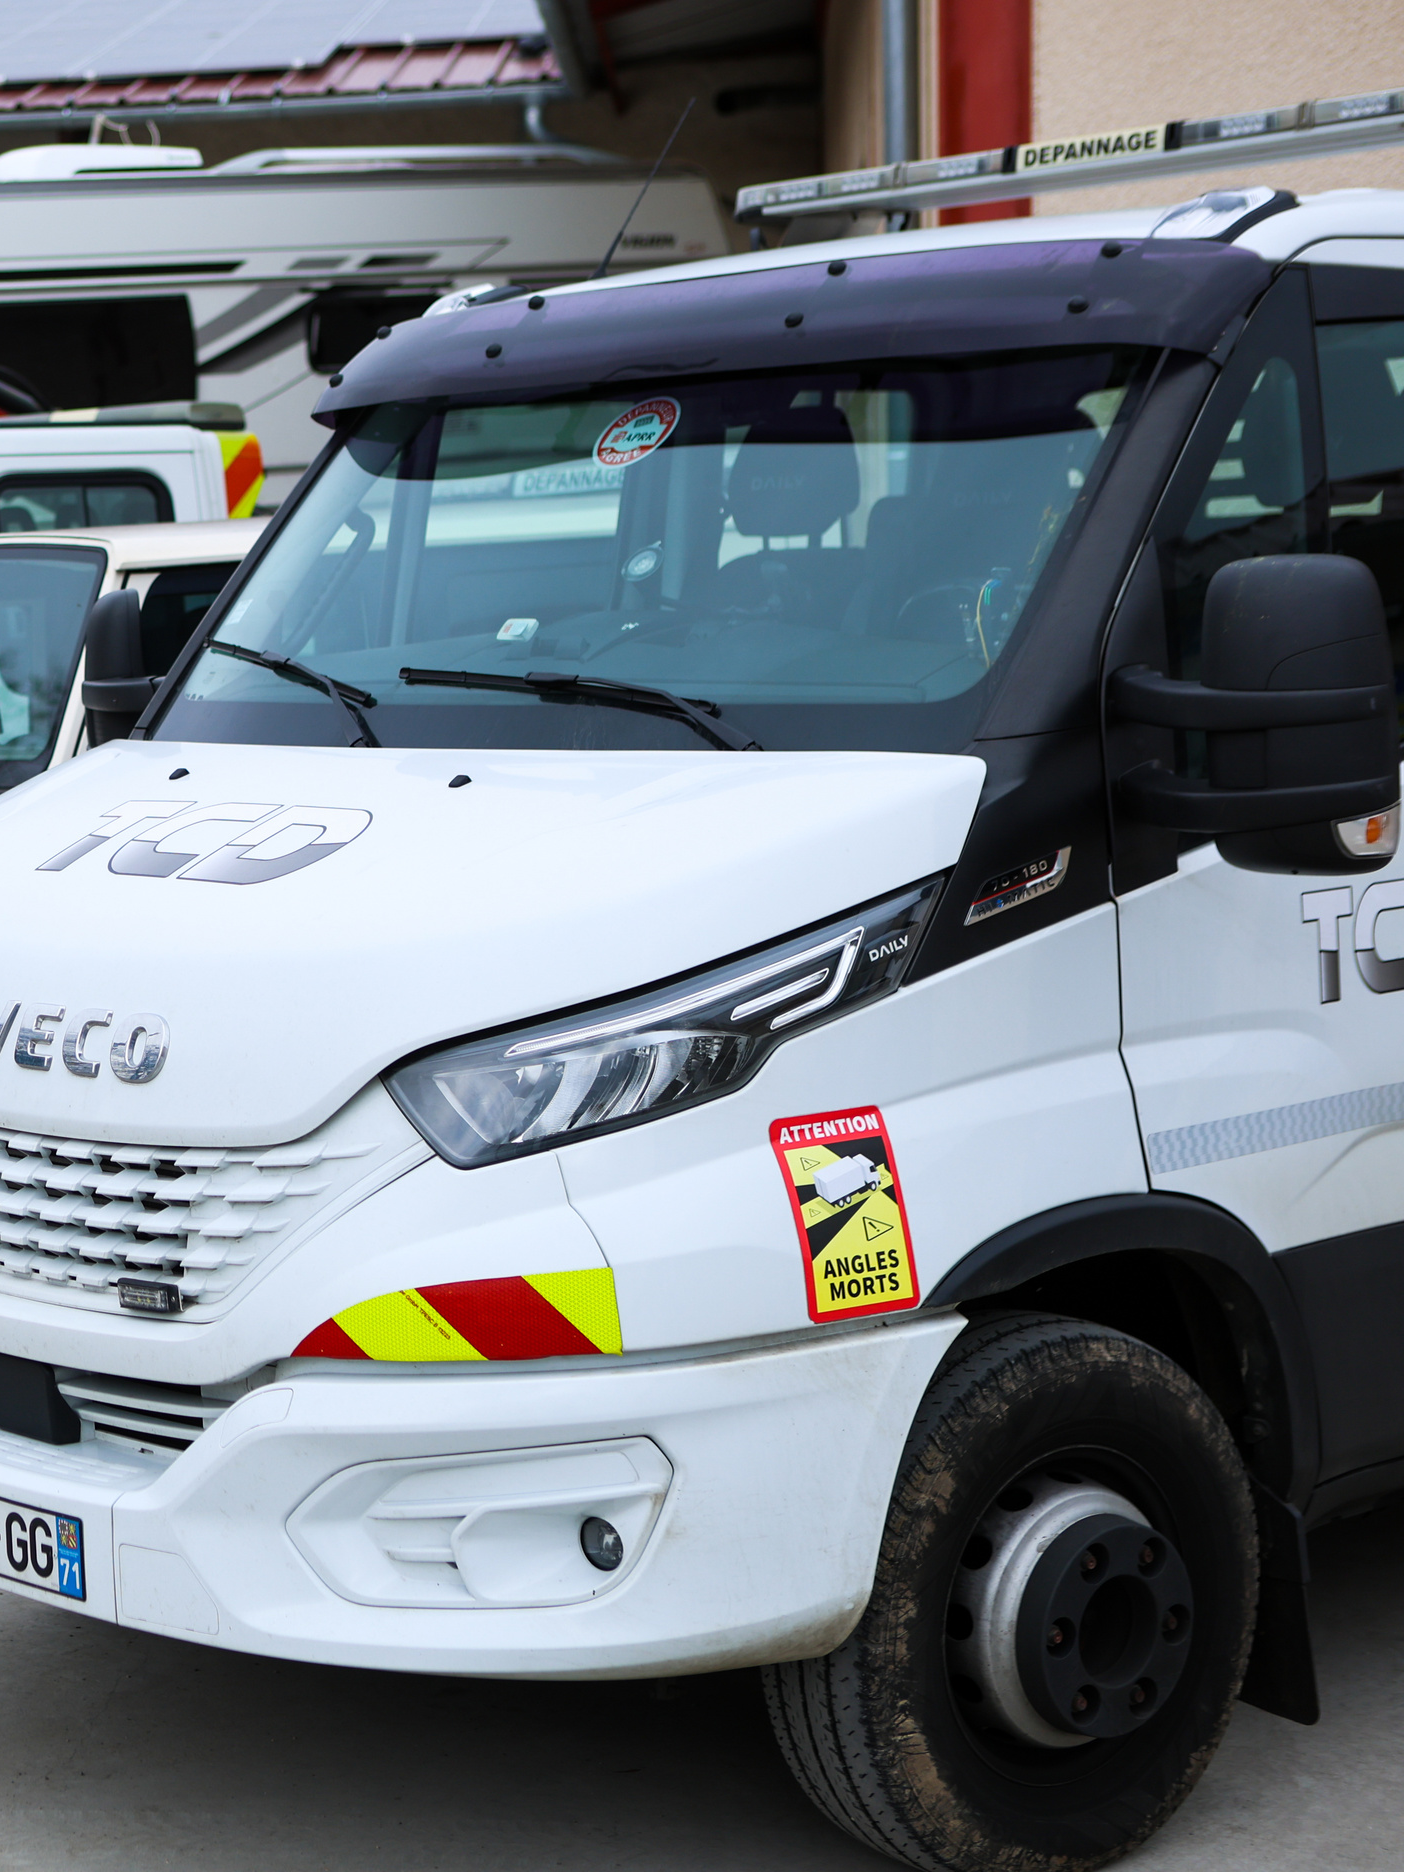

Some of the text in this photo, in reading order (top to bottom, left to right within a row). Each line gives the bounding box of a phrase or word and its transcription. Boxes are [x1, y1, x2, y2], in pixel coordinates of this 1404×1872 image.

[1023, 129, 1158, 167] DEPANNAGE
[617, 402, 674, 426] DEPANNEUR
[624, 431, 657, 443] APRR
[751, 474, 806, 491] DAILY
[34, 800, 374, 886] TCD
[991, 876, 1010, 892] 70
[1022, 859, 1048, 879] 180
[868, 934, 909, 963] DAILY
[779, 1113, 880, 1145] ATTENTION
[823, 1248, 900, 1279] ANGLES
[829, 1272, 900, 1301] MORTS
[59, 1557, 81, 1590] 71
